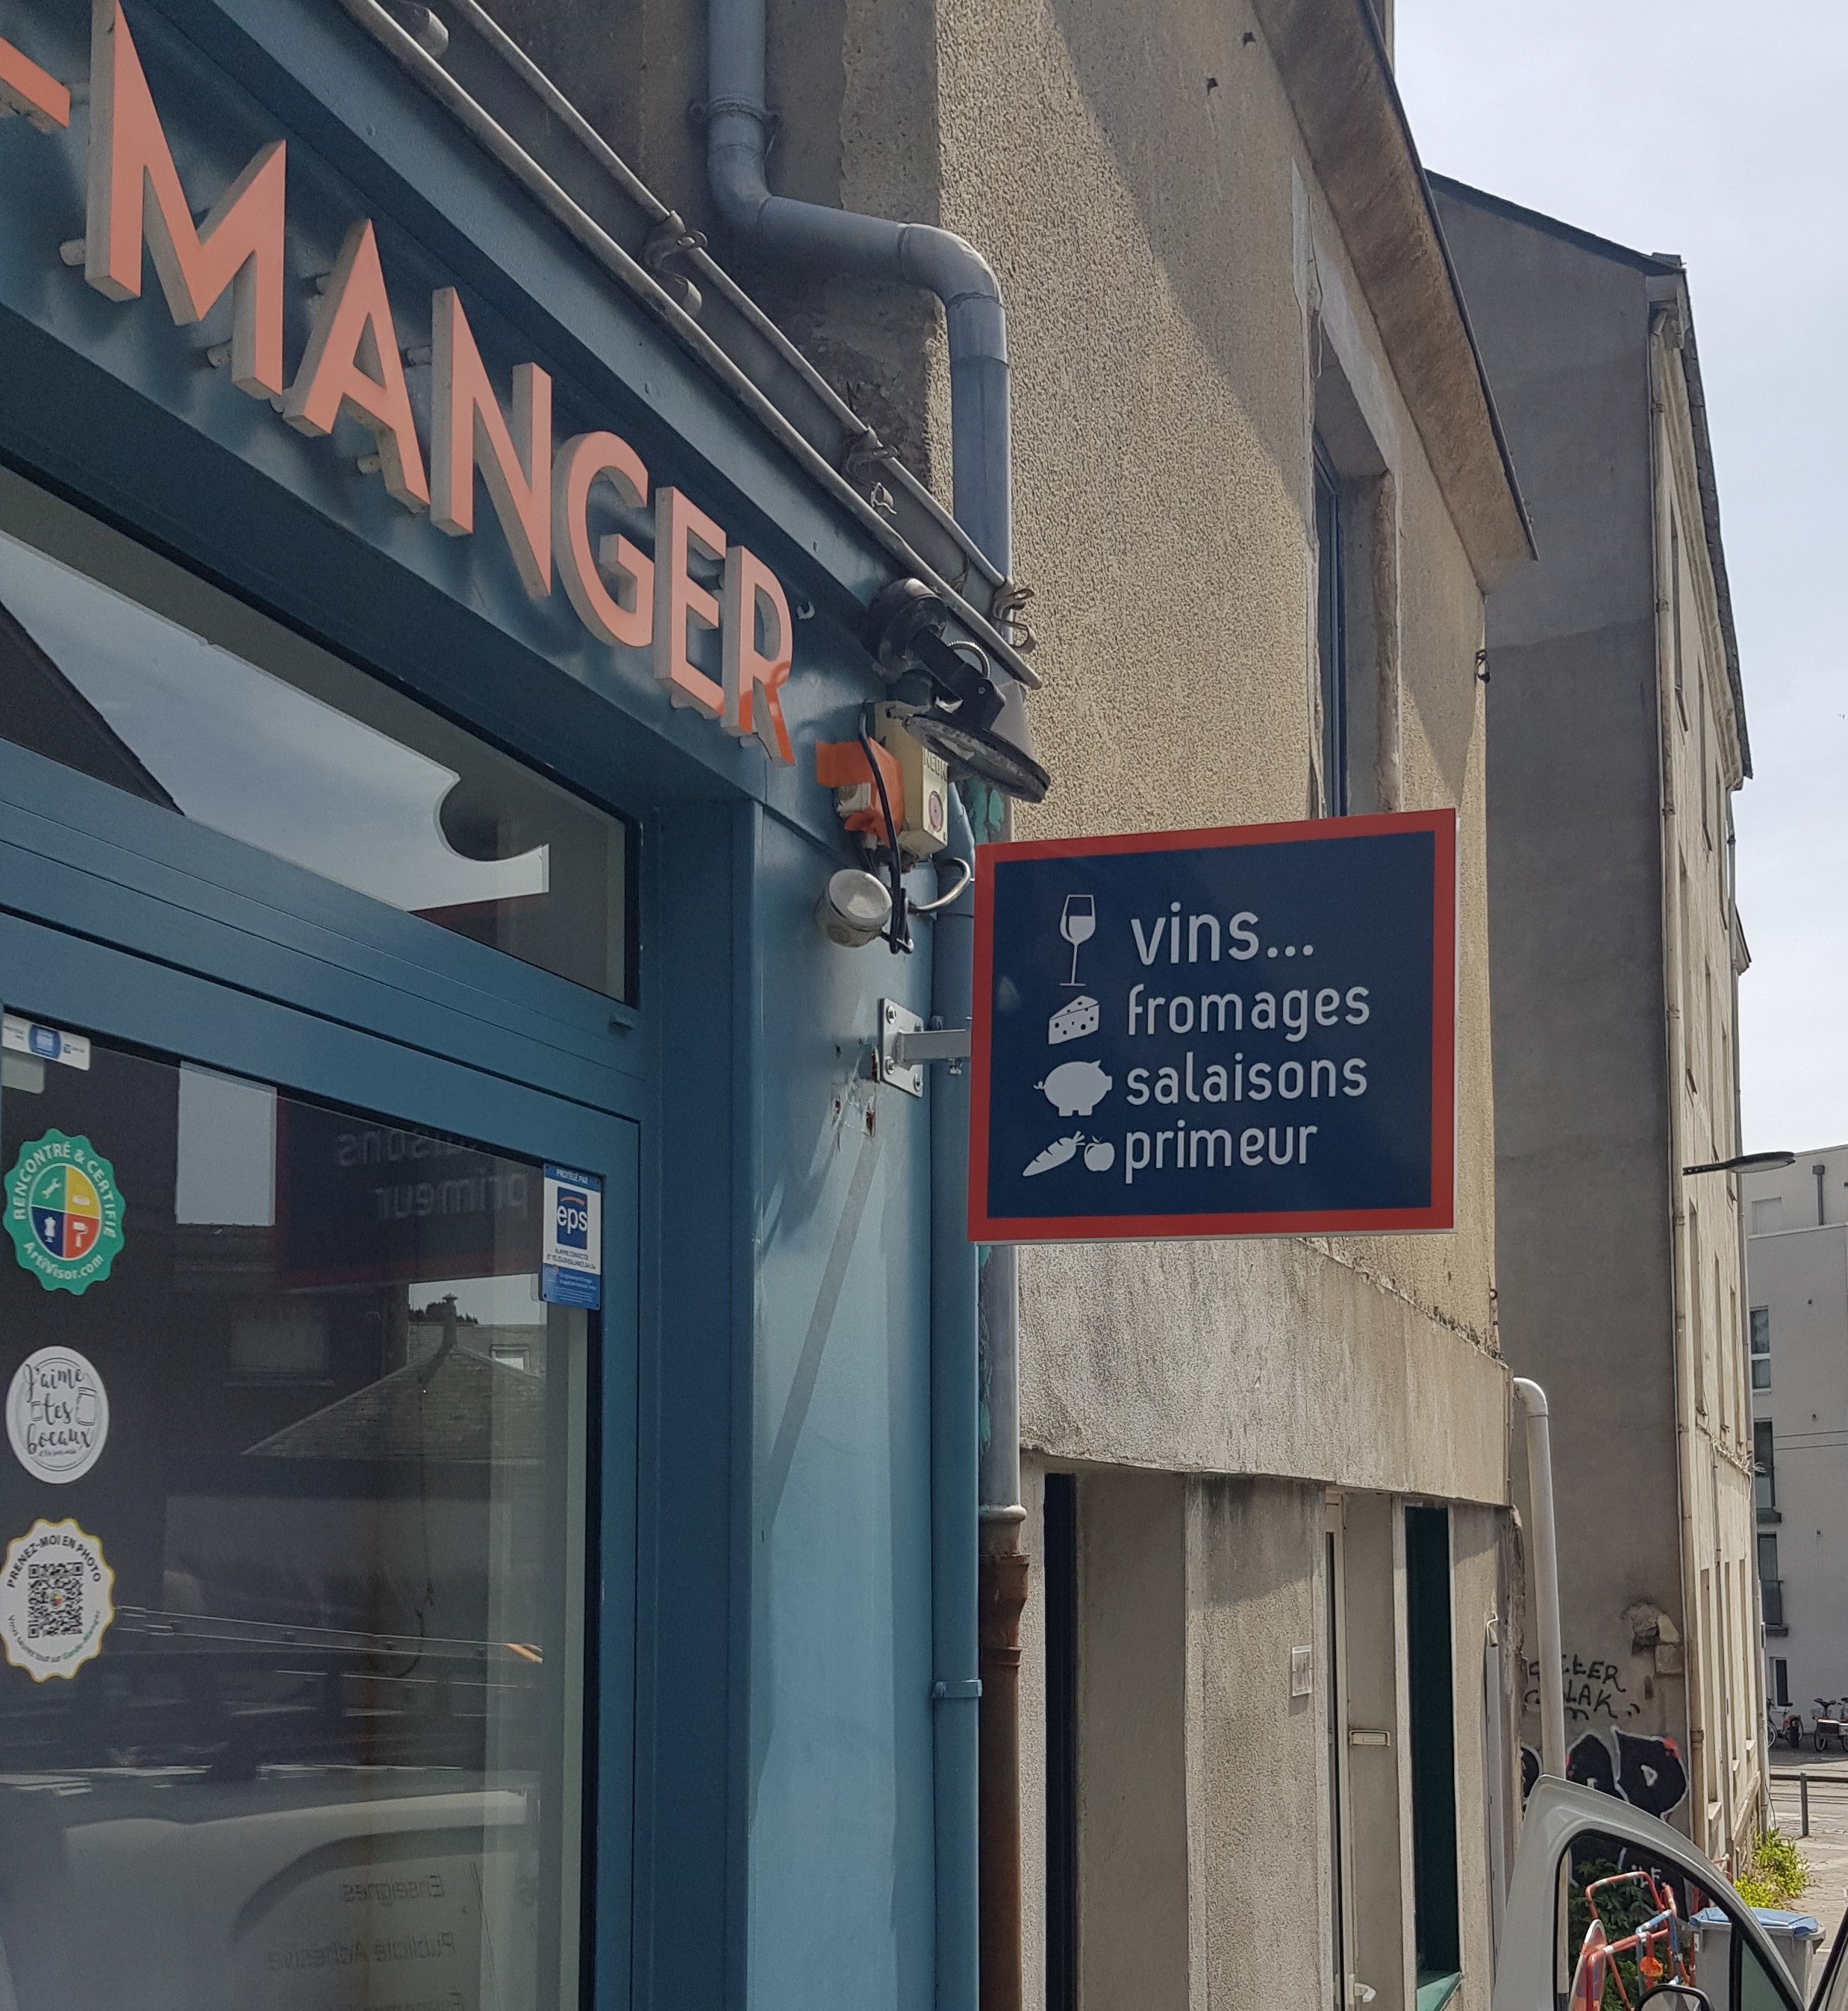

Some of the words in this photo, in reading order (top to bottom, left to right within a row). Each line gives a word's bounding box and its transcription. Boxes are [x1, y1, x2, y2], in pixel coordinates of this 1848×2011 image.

[1130, 901, 1314, 966] vins...
[1127, 983, 1370, 1042] fromages
[1126, 1051, 1367, 1106] salaisons
[1125, 1119, 1318, 1184] primeur
[556, 1204, 588, 1235] eps
[75, 1544, 102, 1583] PHOTO
